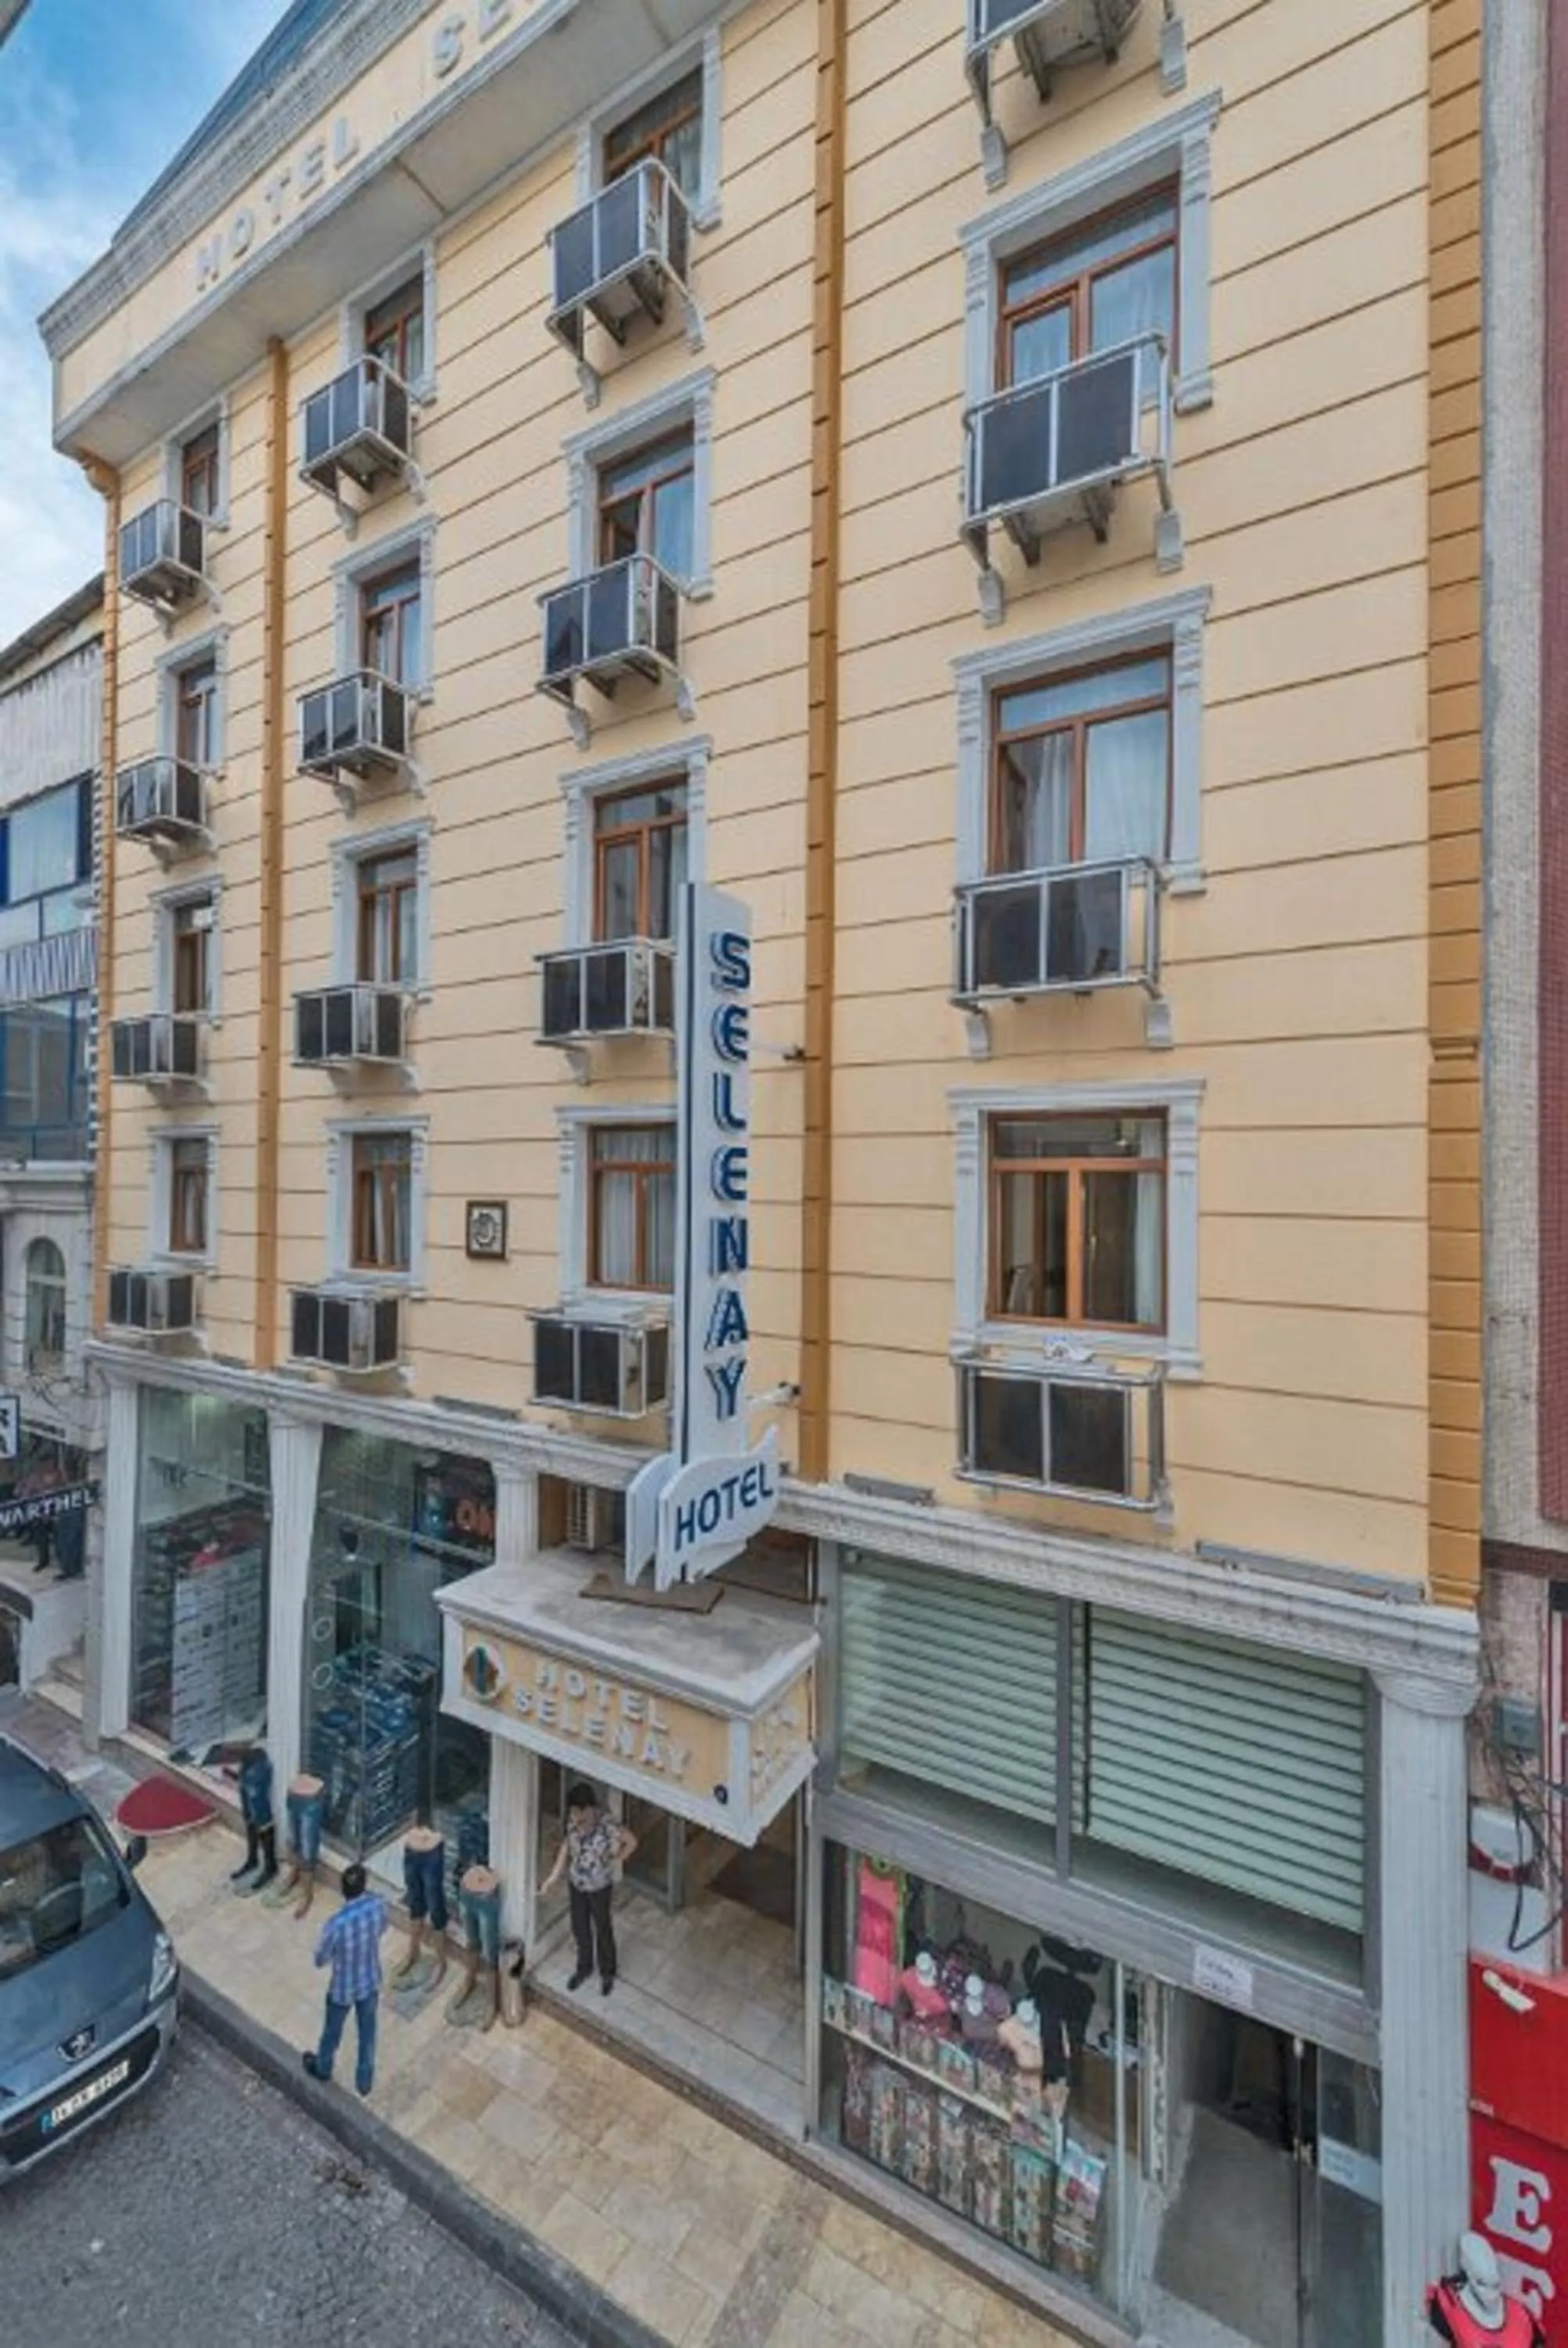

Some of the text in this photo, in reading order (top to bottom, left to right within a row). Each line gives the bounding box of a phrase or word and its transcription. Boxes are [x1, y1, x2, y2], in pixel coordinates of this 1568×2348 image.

[195, 116, 360, 292] HOTEL
[707, 931, 750, 1421] SELENAY
[674, 1460, 774, 1552] HOTEL
[515, 1683, 693, 1781] SELENAY
[536, 1660, 670, 1735] HOTEL
